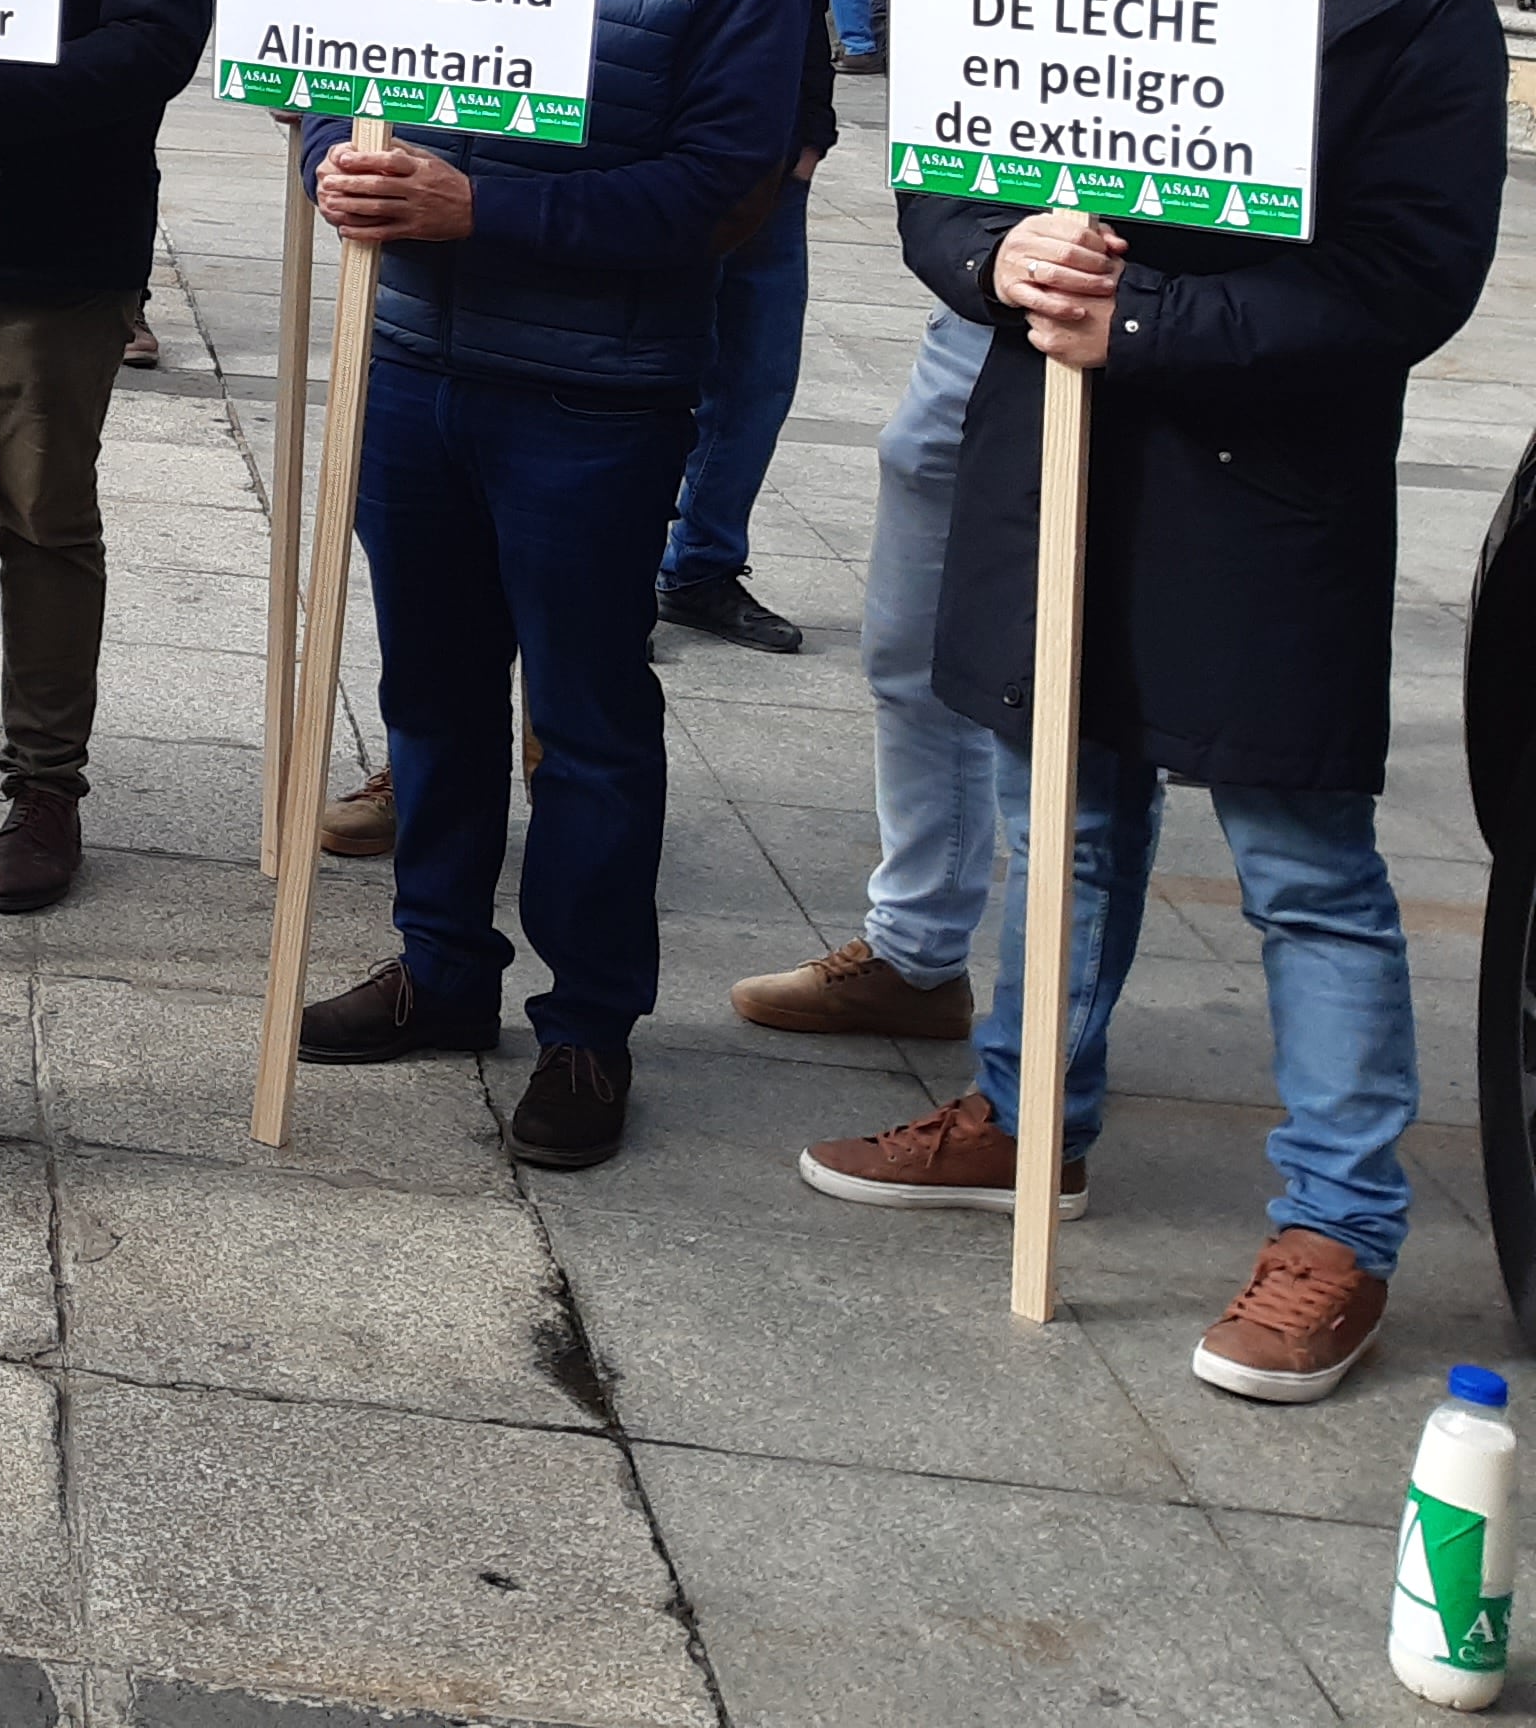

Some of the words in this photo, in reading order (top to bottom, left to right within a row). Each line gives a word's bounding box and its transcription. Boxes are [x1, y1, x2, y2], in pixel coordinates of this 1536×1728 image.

[257, 24, 533, 88] Alimentaria
[963, 54, 1020, 90] en
[1040, 54, 1225, 114] peligro
[382, 85, 425, 100] ASAJA
[457, 93, 501, 108] ASAJA
[536, 101, 581, 117] ASAJA
[935, 101, 992, 146] de
[1010, 115, 1253, 176] extinción
[921, 154, 964, 169] ASAJA
[996, 162, 1042, 178] ASAJA
[1076, 173, 1125, 189] ASAJA
[1160, 182, 1210, 199] ASAJA
[1248, 191, 1299, 209] ASAJA
